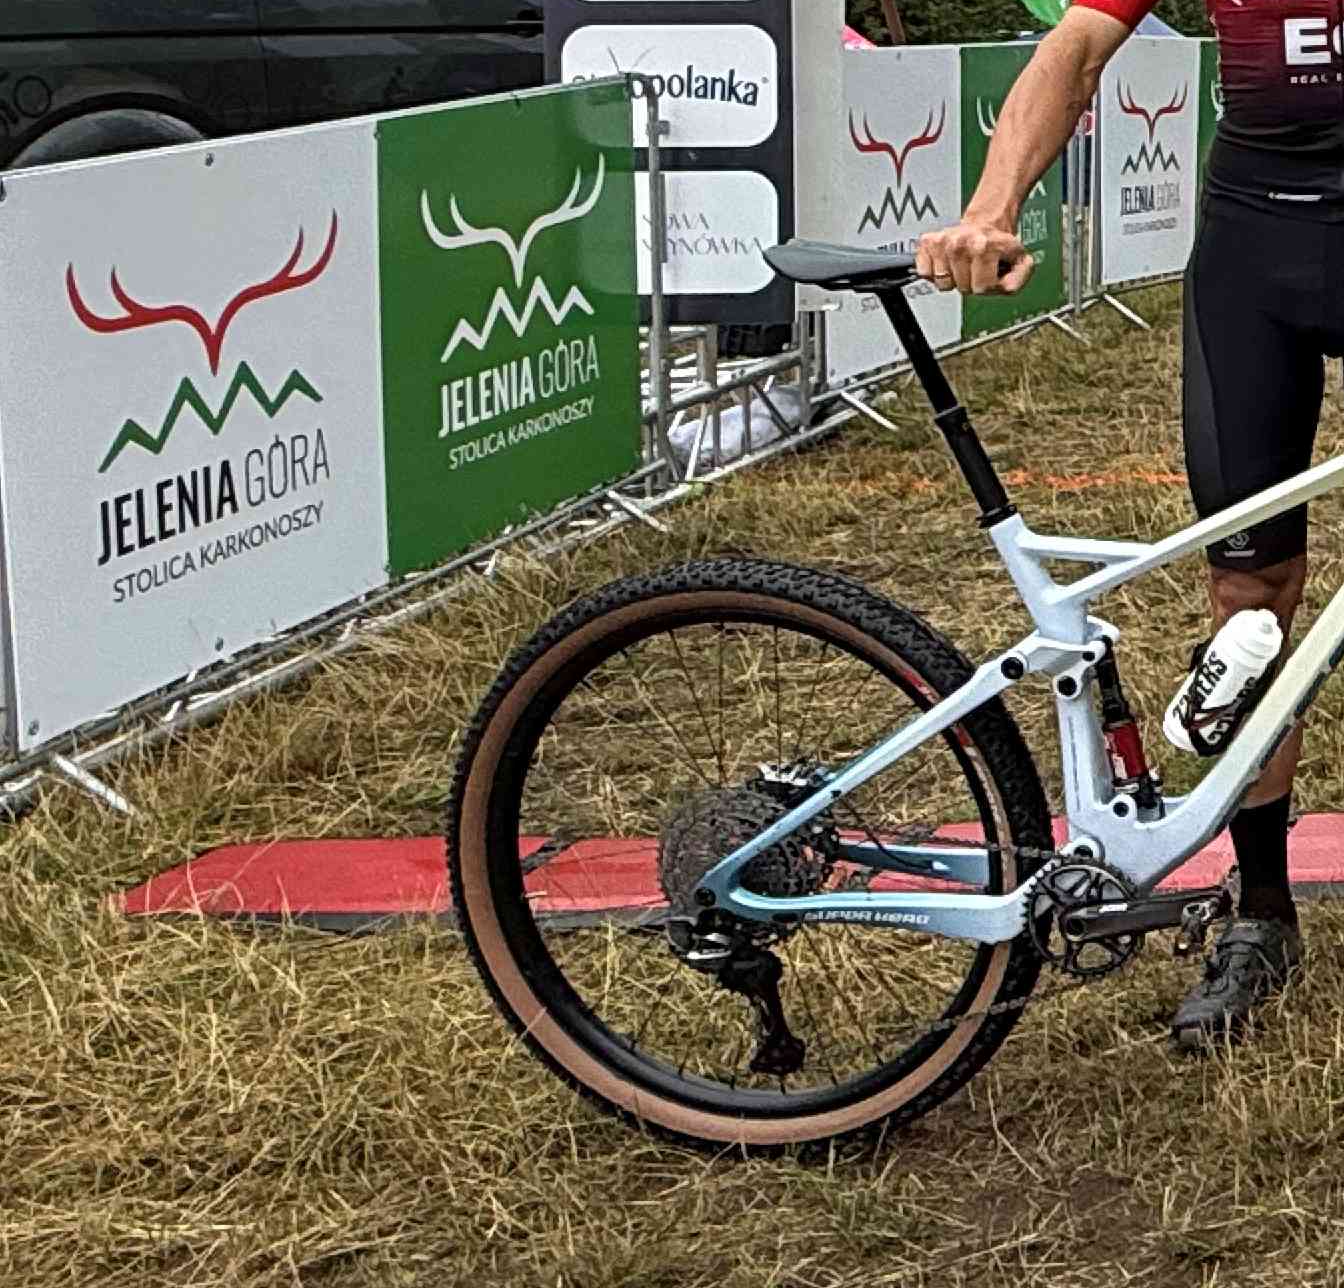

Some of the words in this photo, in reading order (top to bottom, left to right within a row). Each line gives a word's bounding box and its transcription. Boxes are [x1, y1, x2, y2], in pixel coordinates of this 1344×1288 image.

[1290, 75, 1329, 84] REAL
[438, 366, 535, 438] JELENIA
[538, 338, 601, 399] GÓRA
[448, 435, 507, 470] STOLICA
[507, 395, 594, 446] KARKONOSZY
[98, 459, 239, 566] JELENIA
[244, 428, 331, 508] GÓRA
[112, 554, 196, 603] STOLICA
[198, 501, 325, 568] KARKONOSZY
